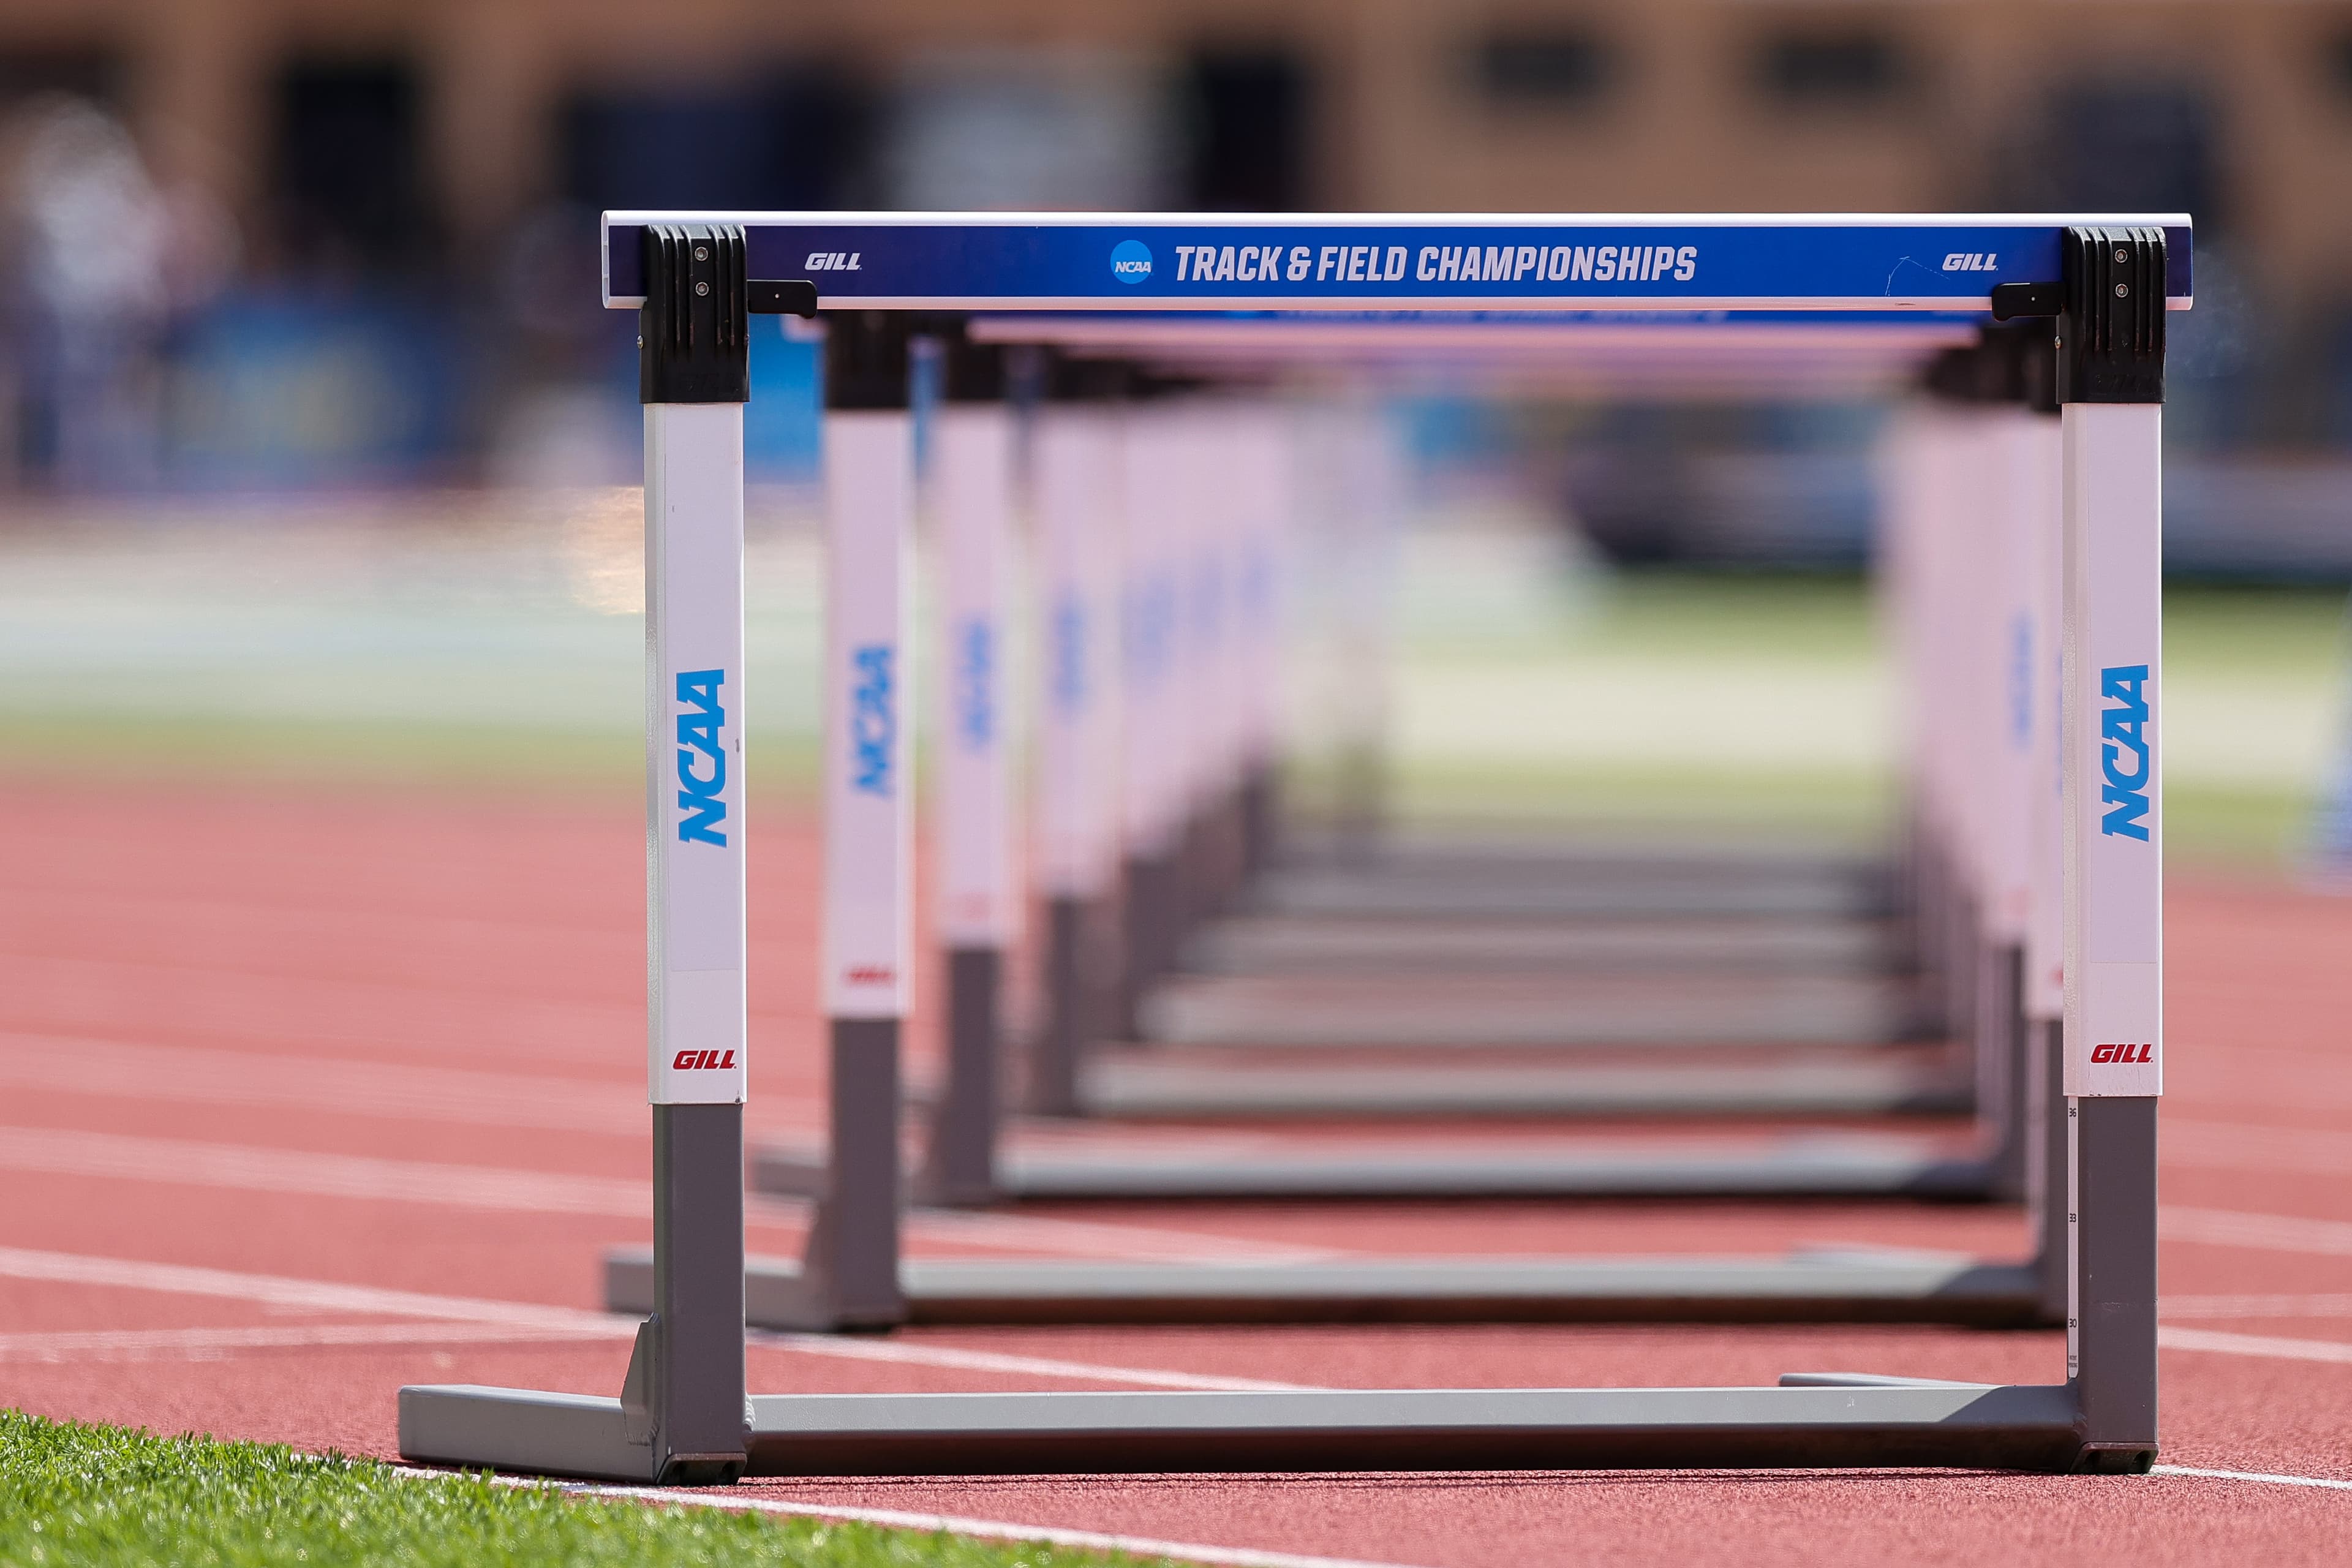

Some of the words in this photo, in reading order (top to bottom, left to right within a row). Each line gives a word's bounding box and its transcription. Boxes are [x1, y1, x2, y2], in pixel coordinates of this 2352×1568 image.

[804, 252, 861, 271] GILL
[1114, 261, 1152, 273] NCAA
[1175, 246, 1283, 282] TRACK
[1286, 246, 1312, 282] &
[1316, 246, 1408, 282] FIELD
[1415, 246, 1698, 282] CHAMPIONSHIPS
[1941, 252, 1999, 271] GILL
[676, 668, 727, 848] NCAA
[2101, 665, 2149, 842] NCAA
[672, 1049, 736, 1070] GILL
[2090, 1043, 2154, 1064] GILL
[2069, 1107, 2076, 1117] 36
[2069, 1213, 2076, 1223] 33
[2069, 1318, 2077, 1328] 30
